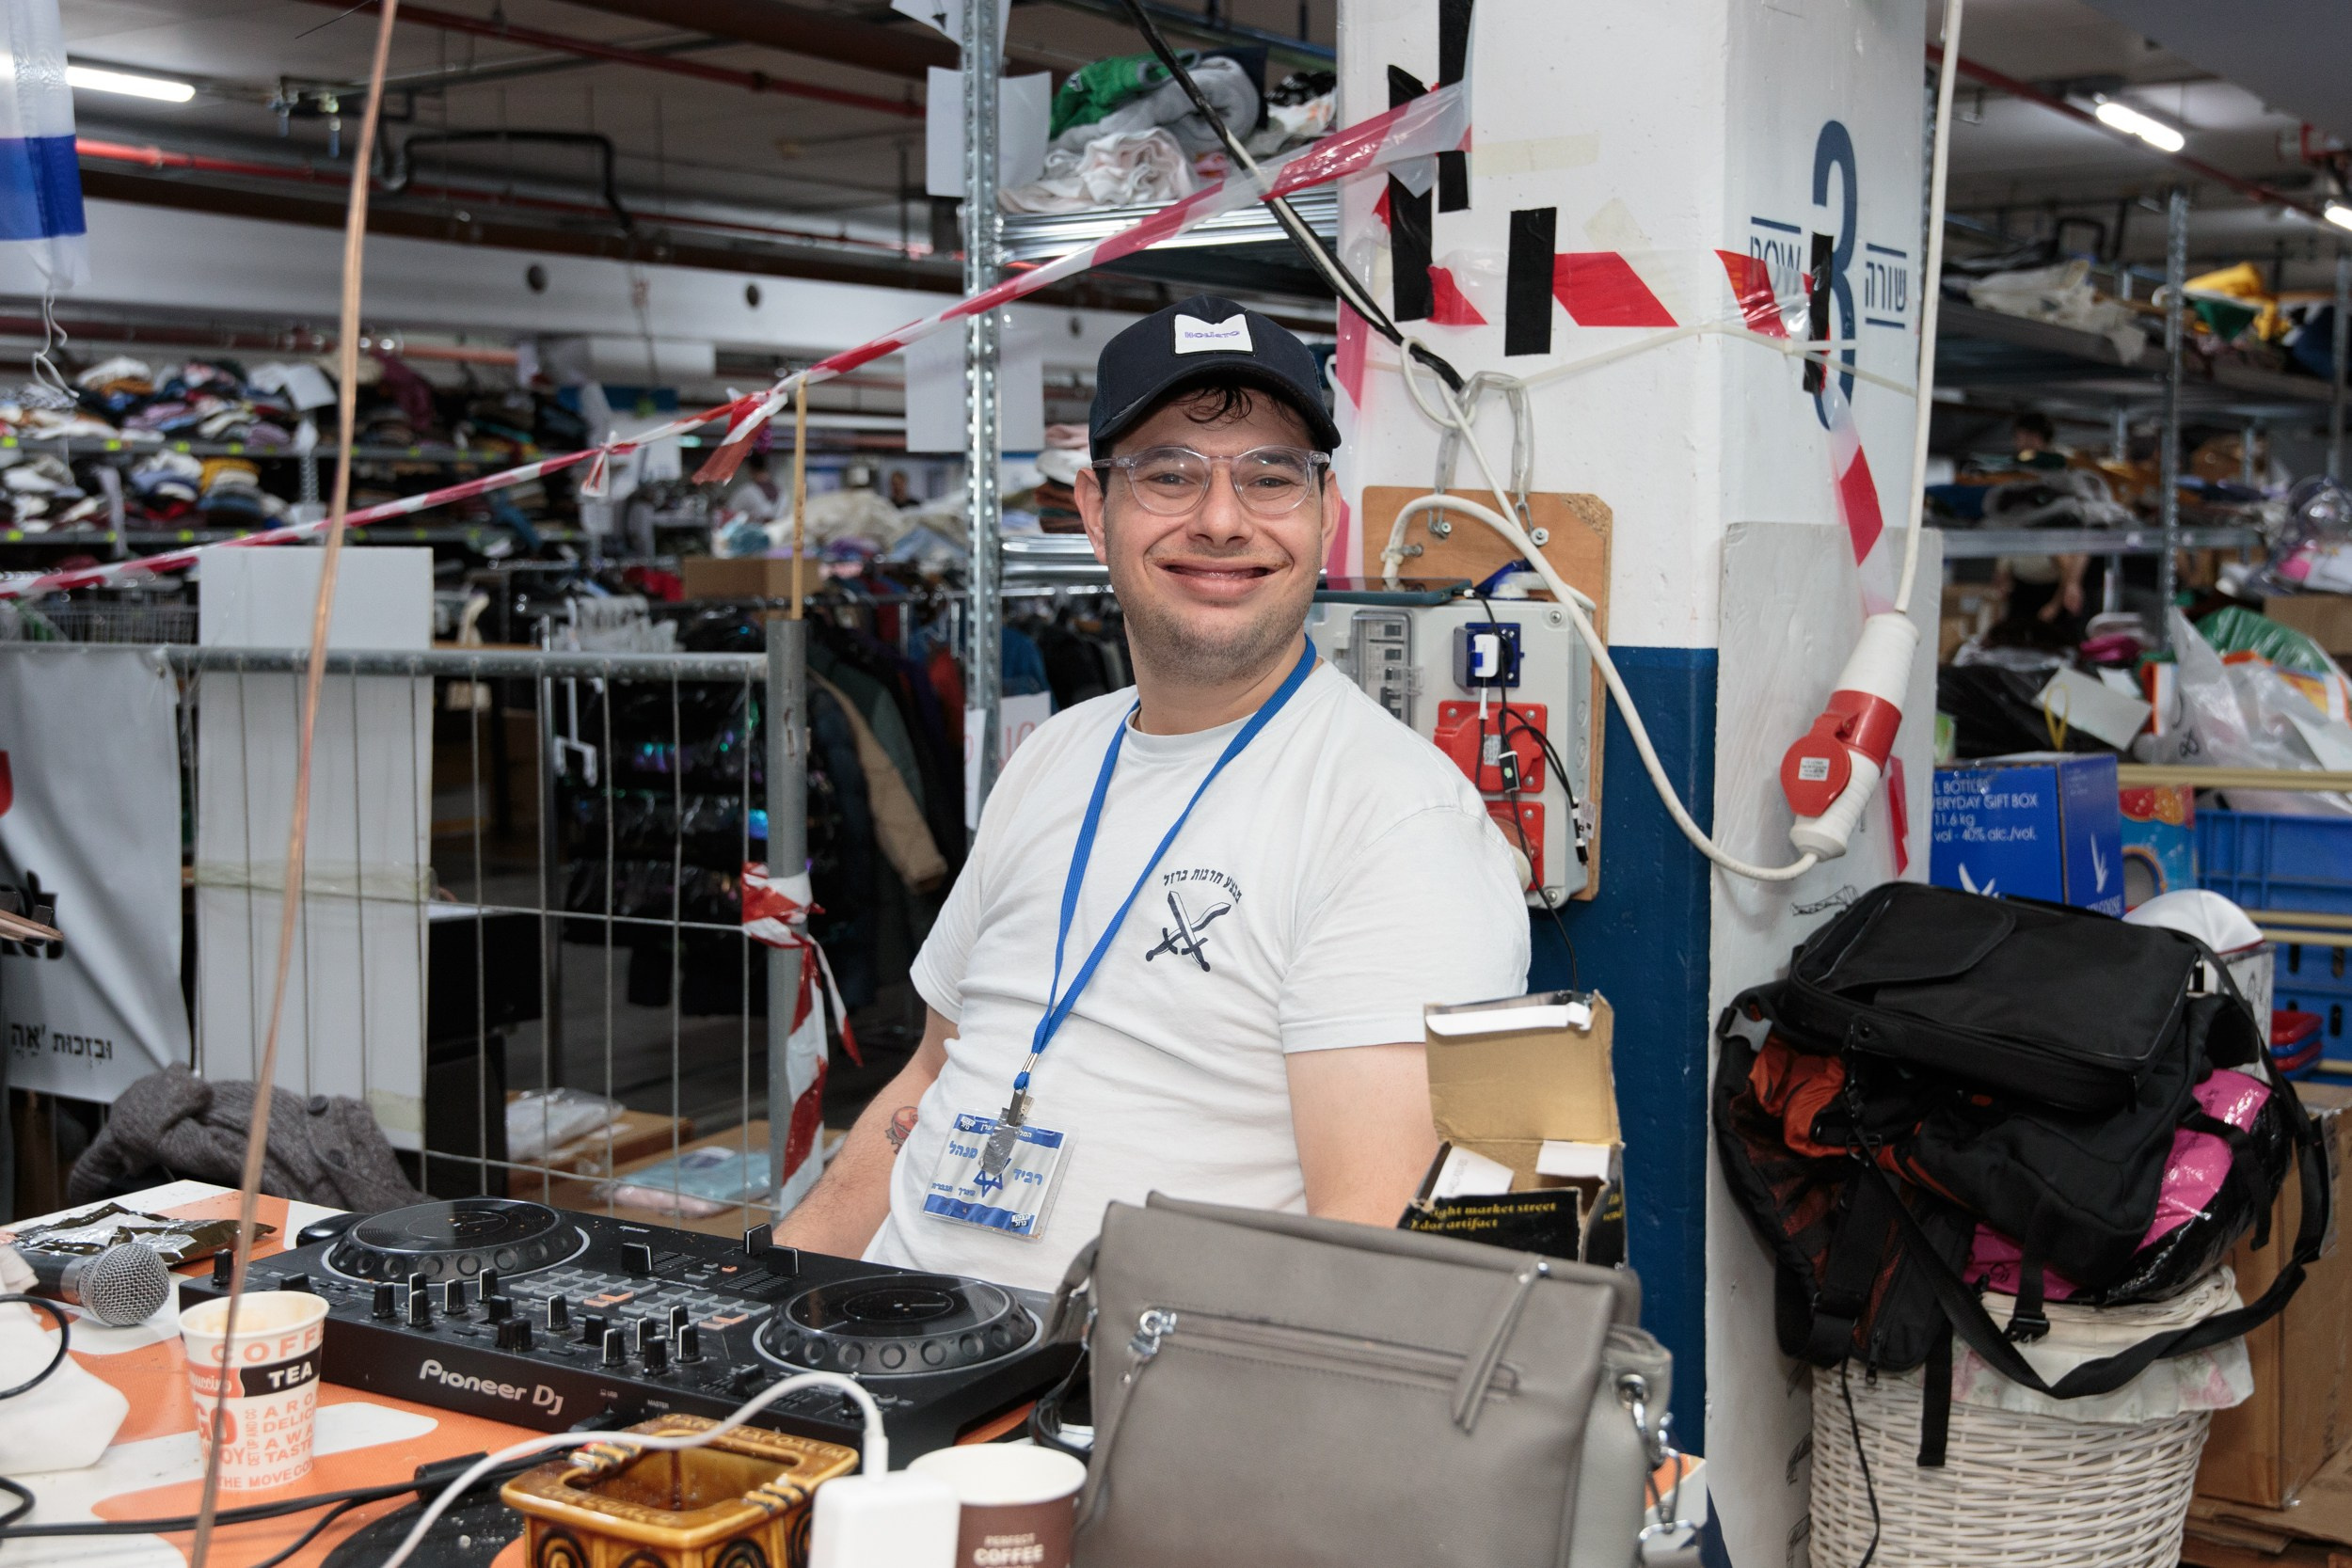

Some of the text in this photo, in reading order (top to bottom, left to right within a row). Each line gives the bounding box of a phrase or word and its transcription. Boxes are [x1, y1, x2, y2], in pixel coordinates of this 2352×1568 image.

[1865, 261, 1907, 313] שורה
[1983, 793, 2010, 810] GIFT
[2011, 792, 2038, 809] BOX
[1959, 812, 1976, 831] kg
[1961, 826, 1985, 843] 40%
[1163, 868, 1243, 905] מבצע חרבות ברזל
[948, 1140, 978, 1160] מנהל
[1012, 1167, 1043, 1186] רביד
[1430, 1202, 1557, 1220] ight market street
[267, 1361, 313, 1389] TEA
[419, 1358, 527, 1402] Pioneer
[973, 1544, 1044, 1566] COFFEE
